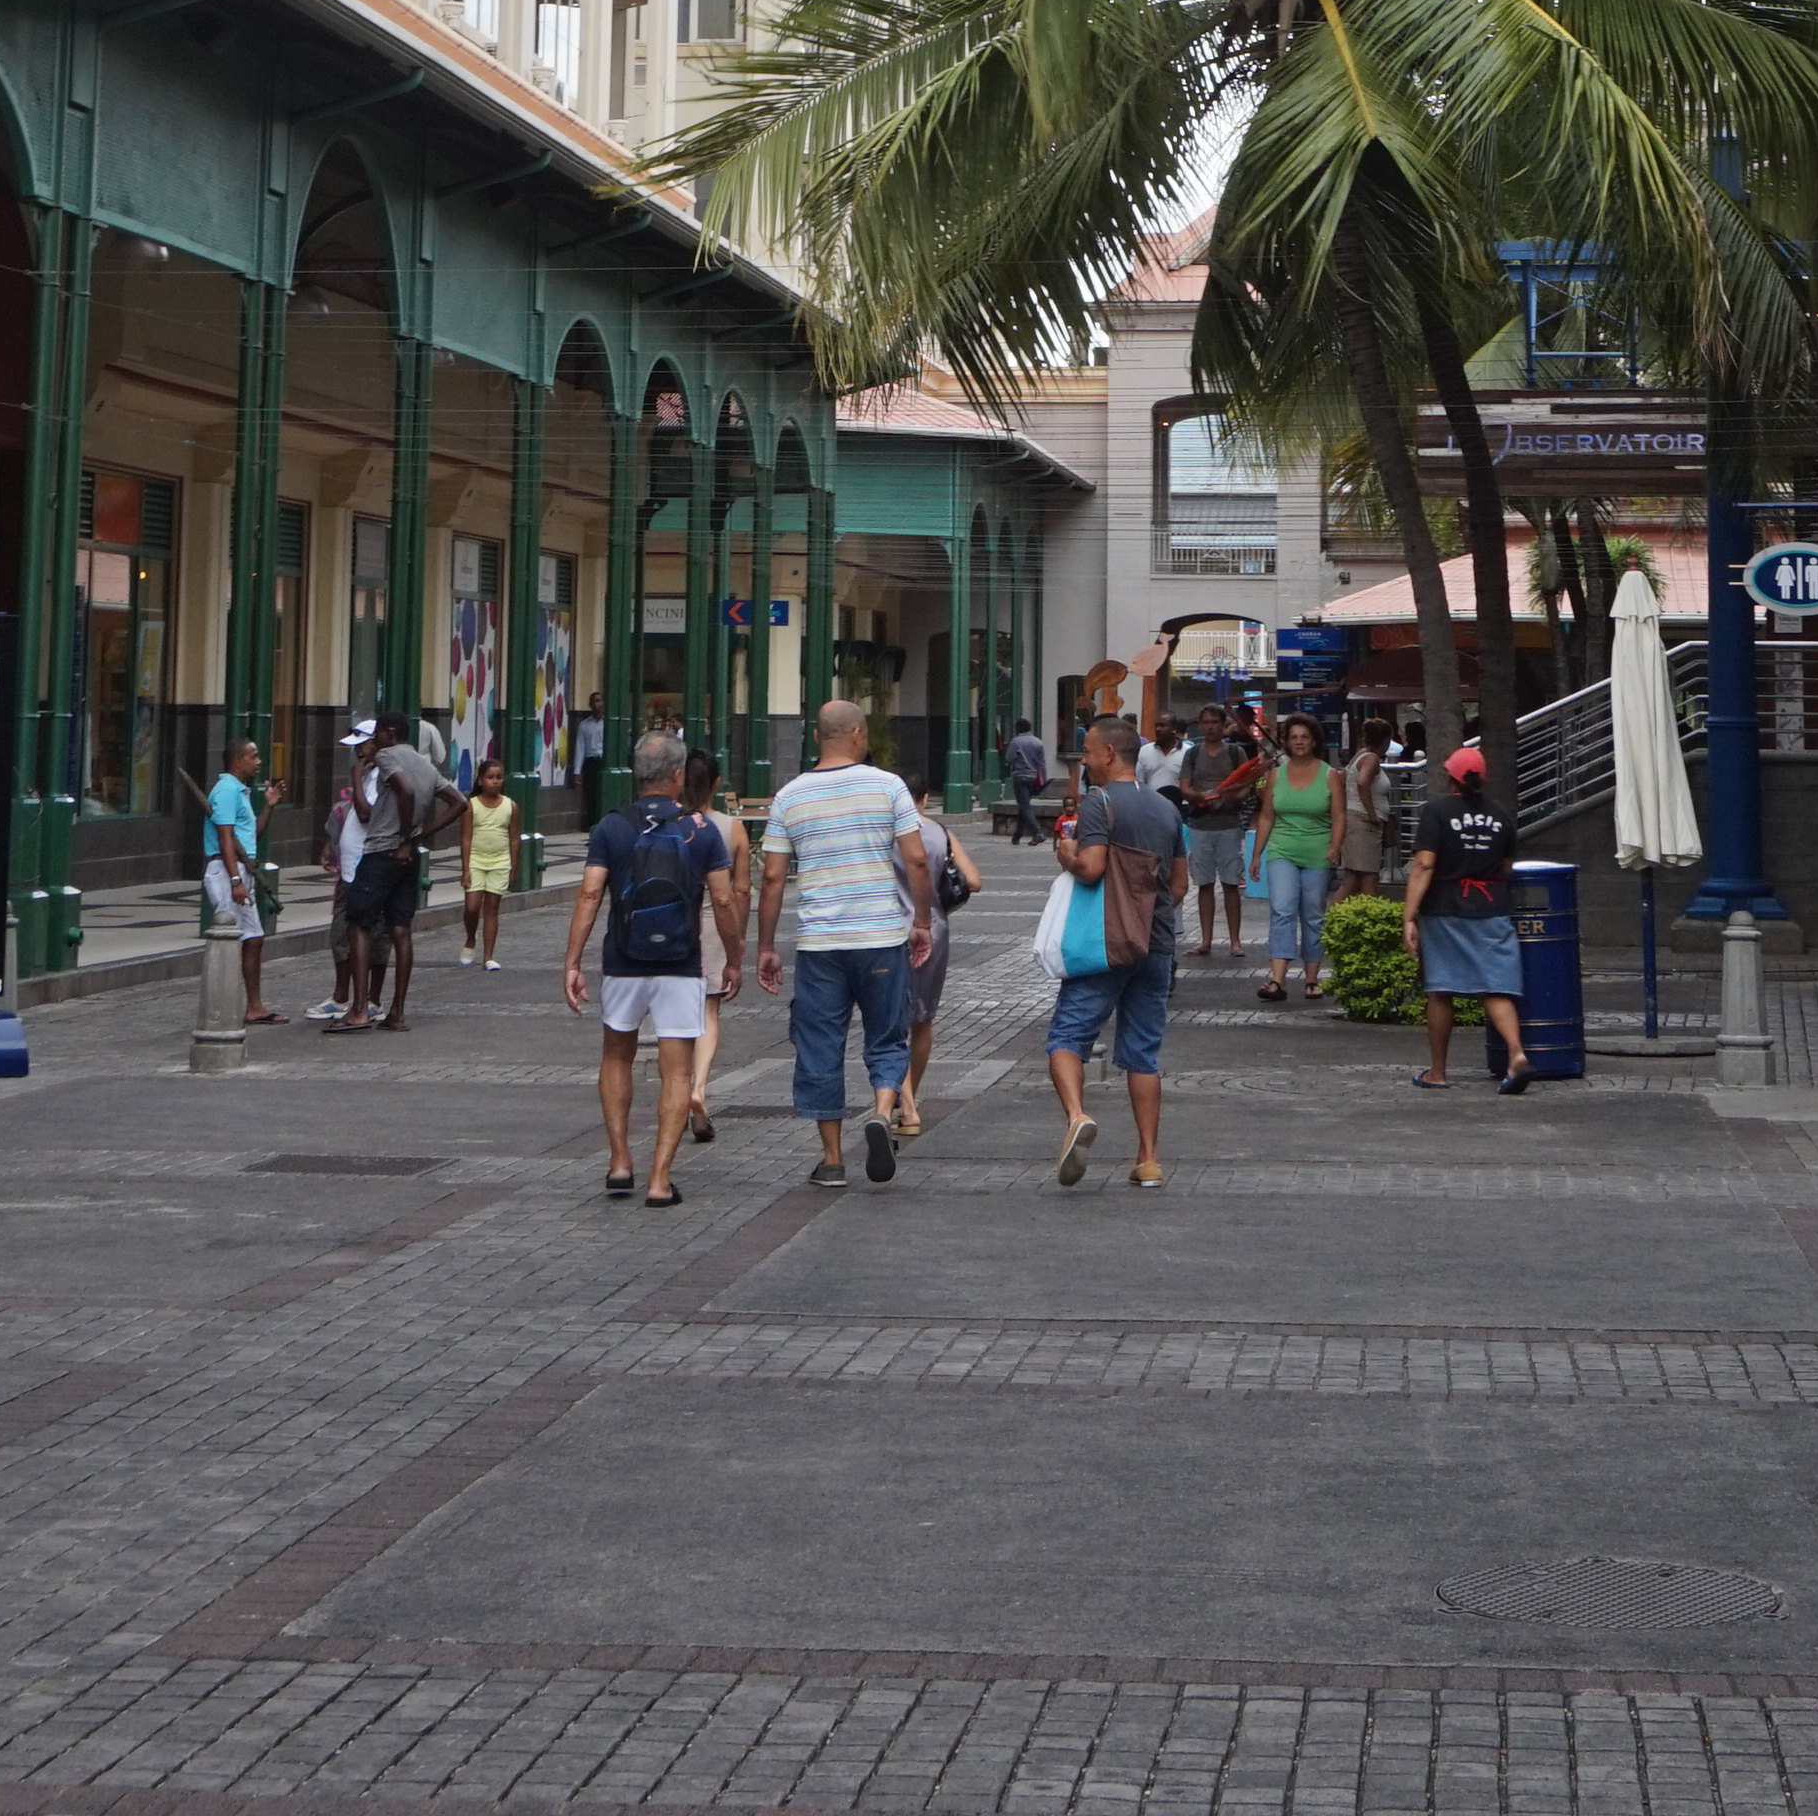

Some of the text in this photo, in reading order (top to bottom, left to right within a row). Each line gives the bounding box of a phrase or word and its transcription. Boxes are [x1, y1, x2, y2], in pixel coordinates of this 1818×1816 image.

[645, 608, 685, 619] NCINI
[1450, 813, 1503, 833] OASIS
[1517, 920, 1547, 935] ER
